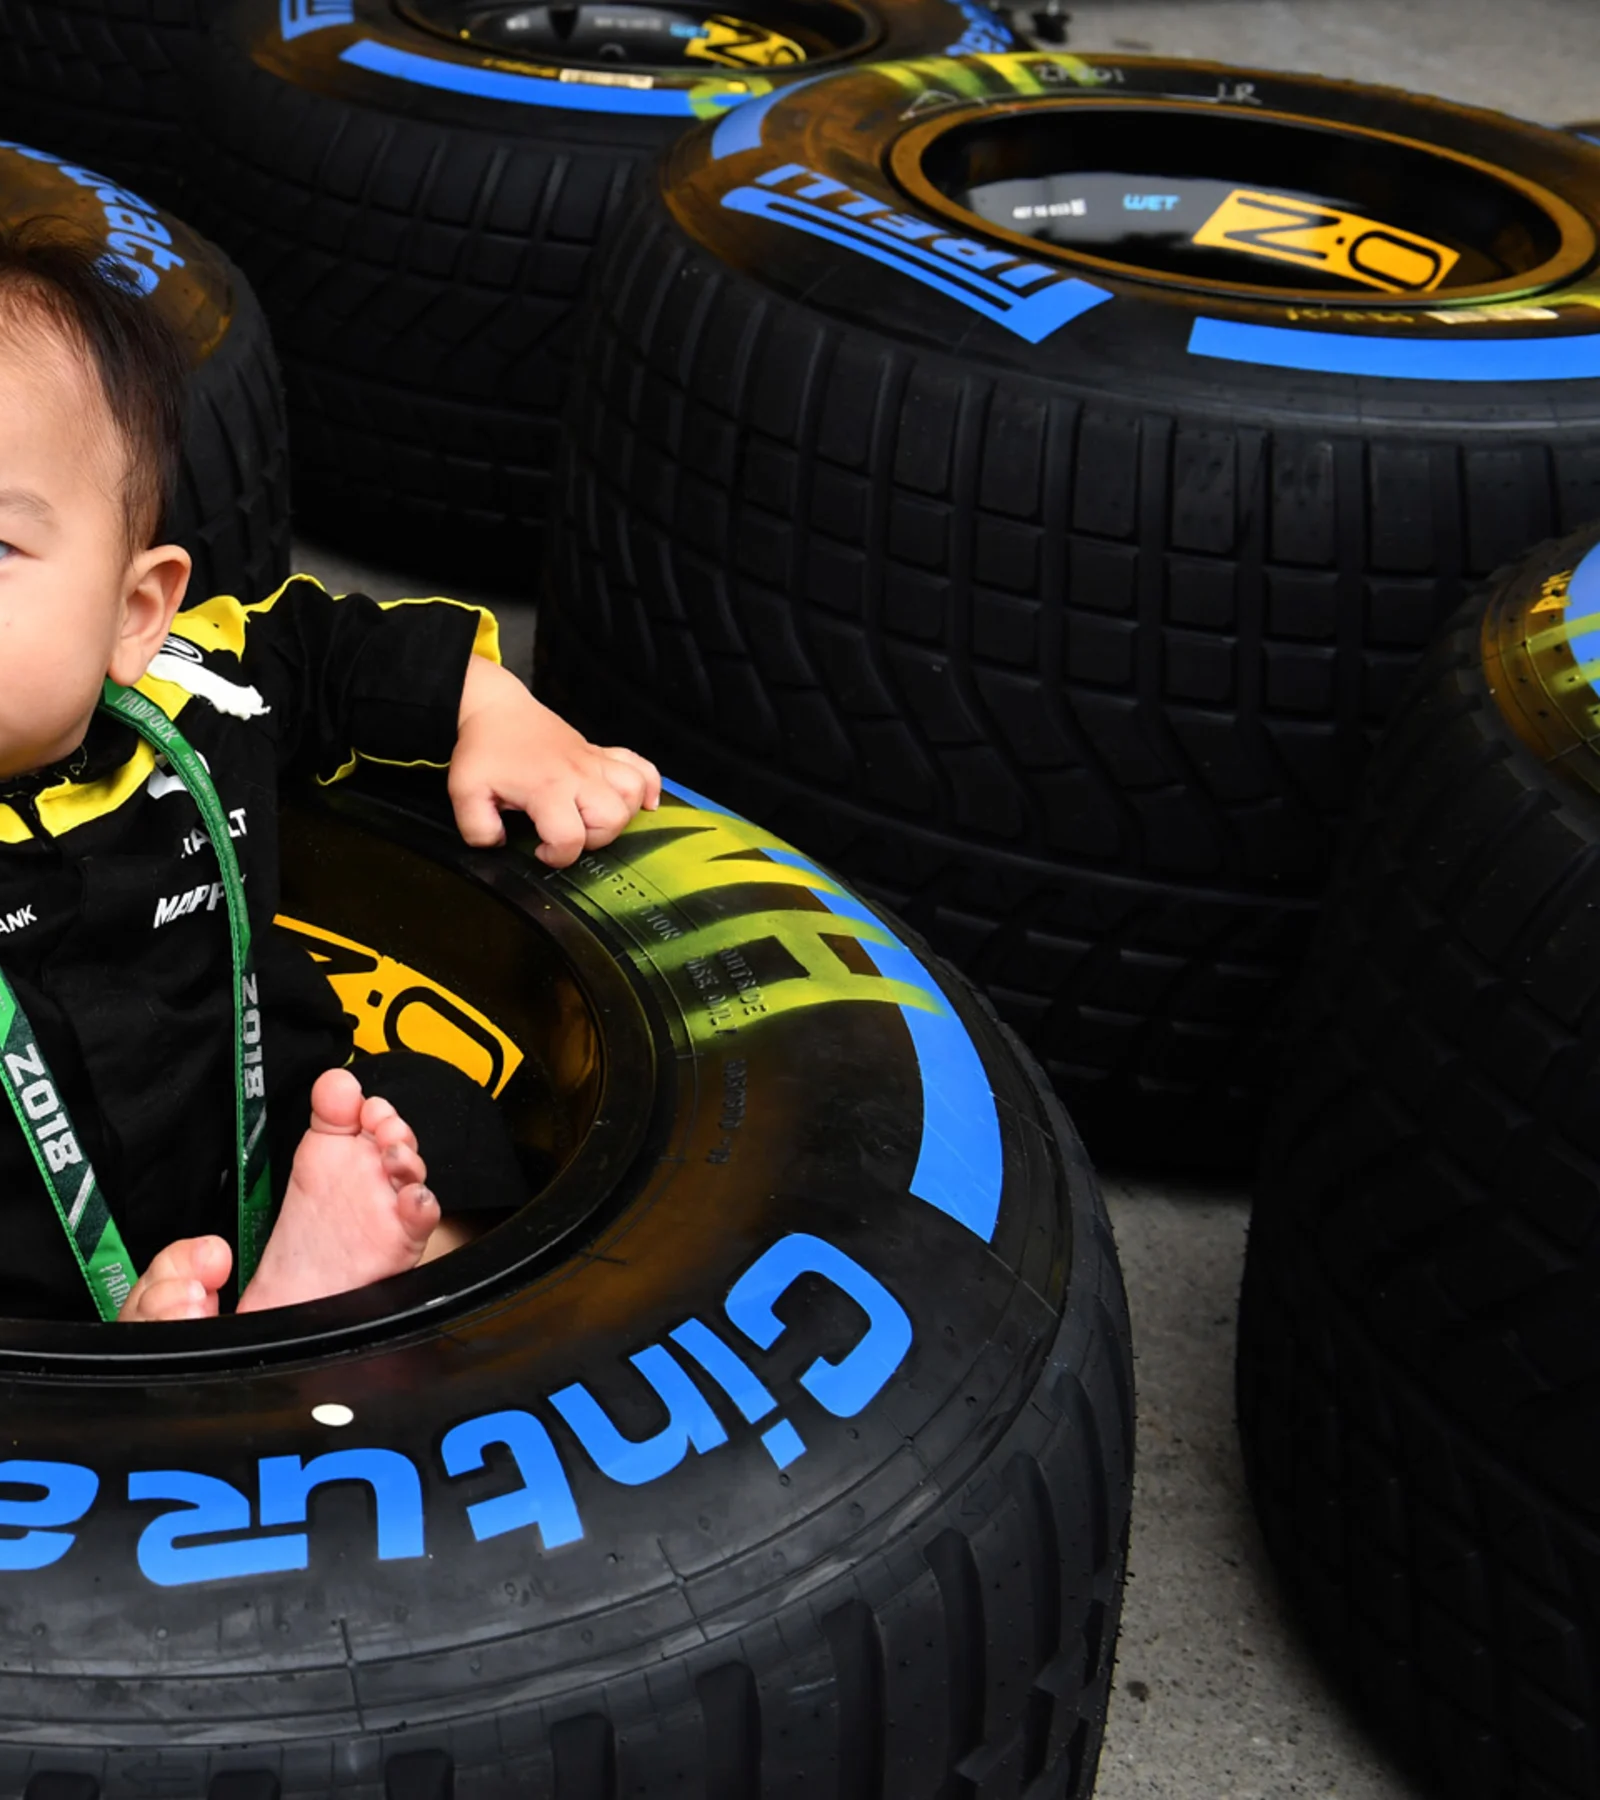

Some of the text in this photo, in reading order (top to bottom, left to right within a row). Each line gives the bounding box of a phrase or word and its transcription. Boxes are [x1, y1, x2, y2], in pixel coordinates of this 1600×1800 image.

[1122, 194, 1180, 211] WET
[115, 690, 180, 744] PADDOCK
[241, 972, 265, 1100] 2018
[3, 1041, 83, 1175] 2018
